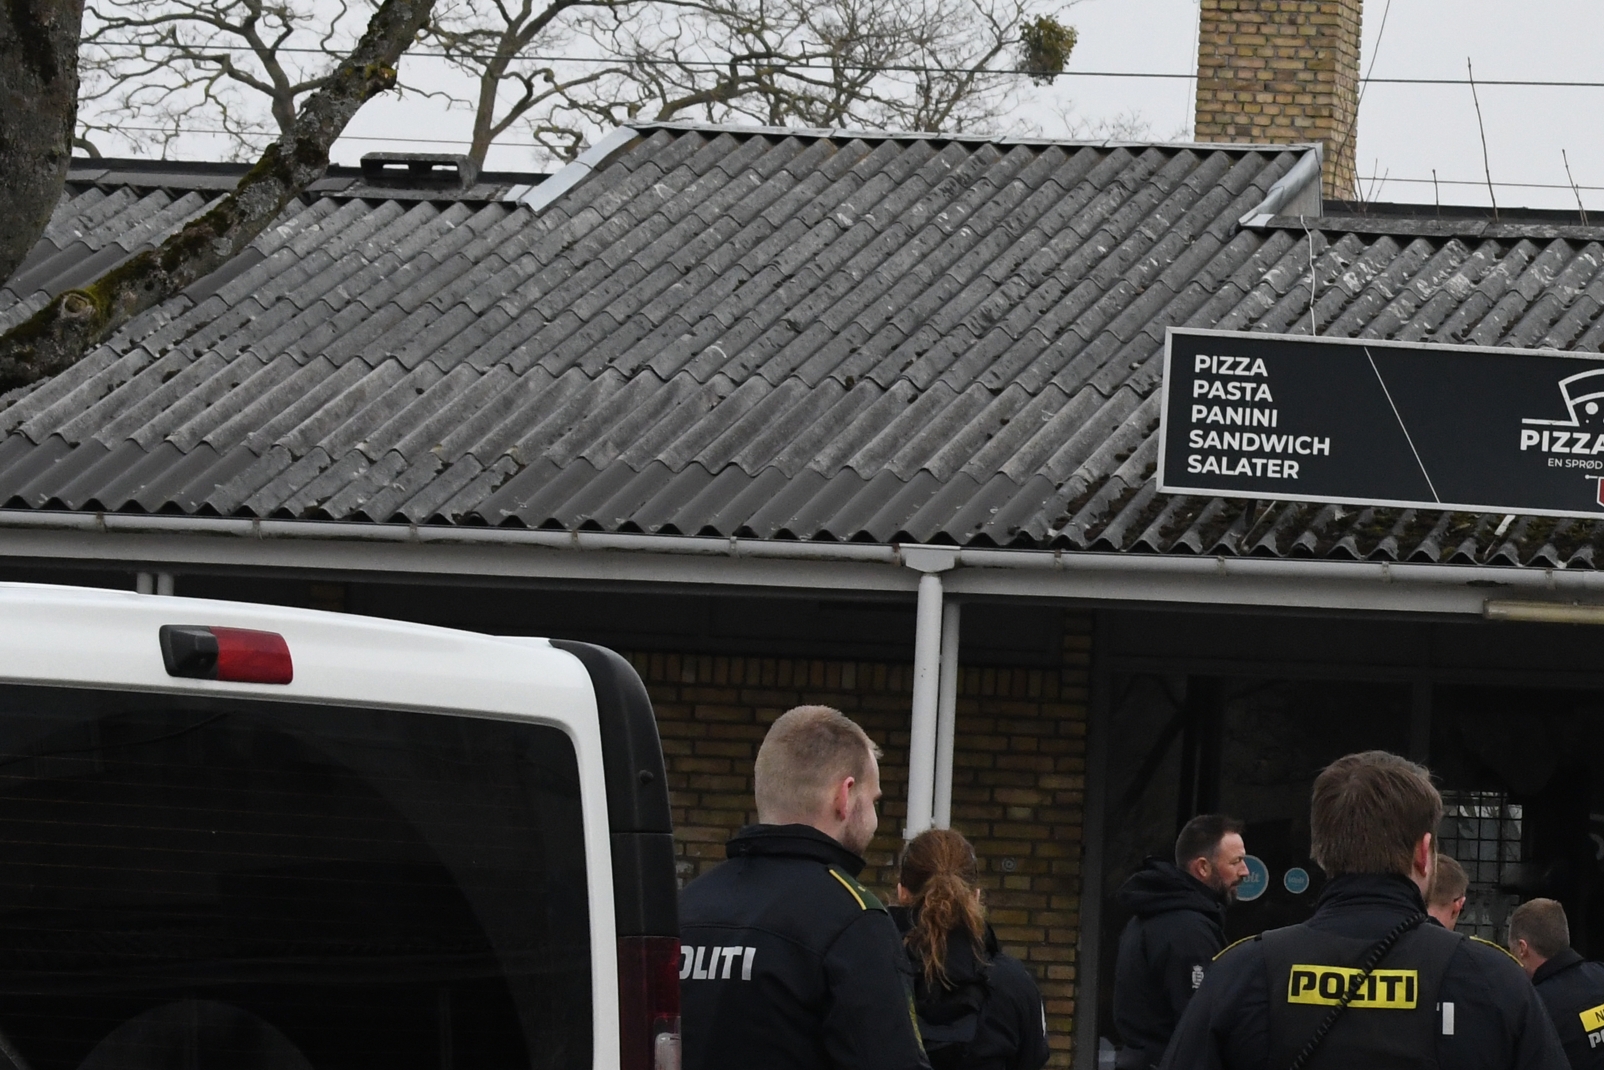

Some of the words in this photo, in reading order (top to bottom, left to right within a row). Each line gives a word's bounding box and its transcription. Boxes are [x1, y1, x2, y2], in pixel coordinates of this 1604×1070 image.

[1194, 354, 1268, 377] PIZZA
[1193, 380, 1273, 402] PASTA
[1191, 404, 1278, 428] PANINI
[1188, 430, 1330, 456] SANDWICH
[1187, 454, 1299, 479] SALATER
[1547, 457, 1563, 467] EN
[1565, 458, 1603, 471] SPRØD
[679, 945, 757, 981] OLITI
[1291, 971, 1415, 1003] POLITI
